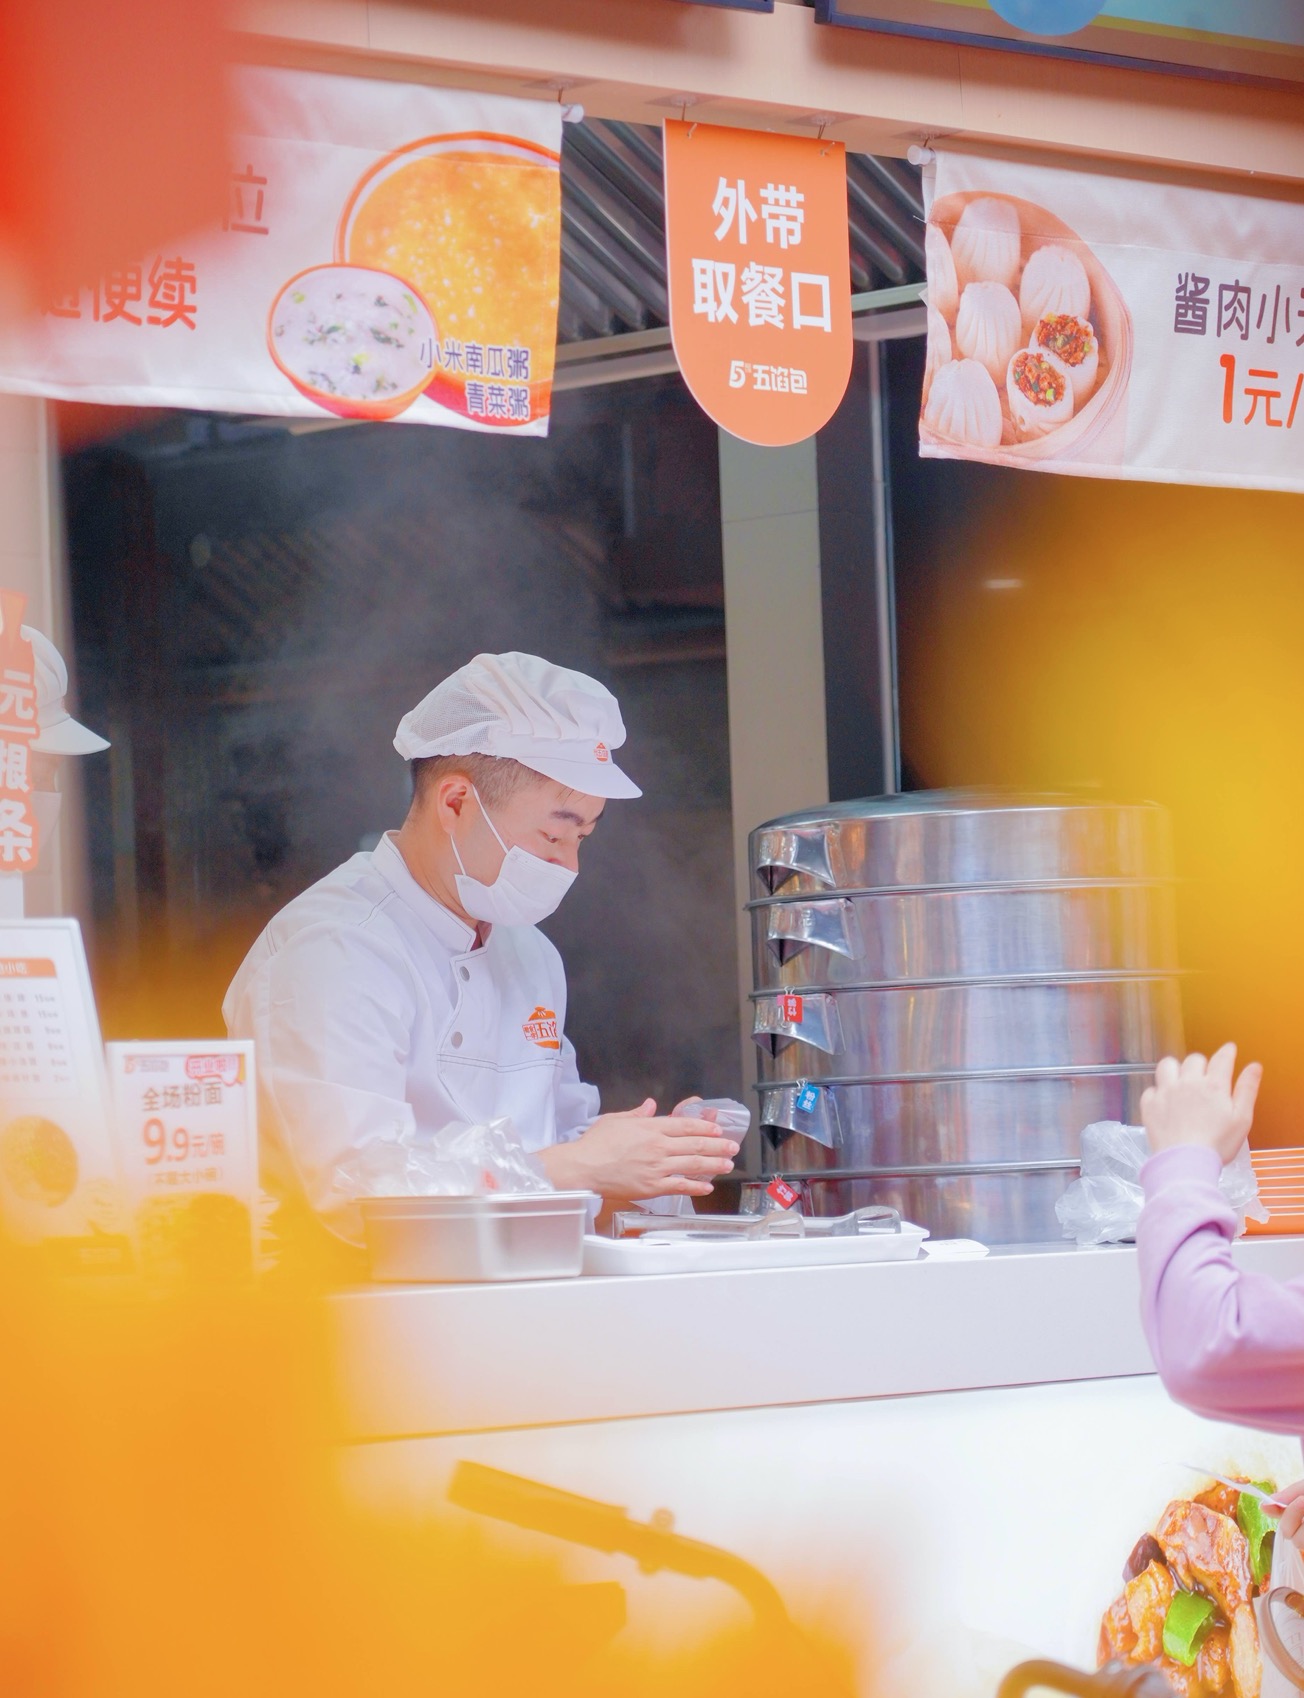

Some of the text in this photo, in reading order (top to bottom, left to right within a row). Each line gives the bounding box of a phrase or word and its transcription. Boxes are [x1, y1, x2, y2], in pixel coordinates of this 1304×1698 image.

[712, 176, 805, 249] 外带
[691, 257, 832, 333] 取餐口
[1174, 272, 1304, 347] 酱肉小
[420, 338, 530, 380] 小米南瓜粥
[752, 364, 808, 395] 五馅包
[466, 382, 529, 418] 青菜粥
[142, 1082, 222, 1111] 全场粉面
